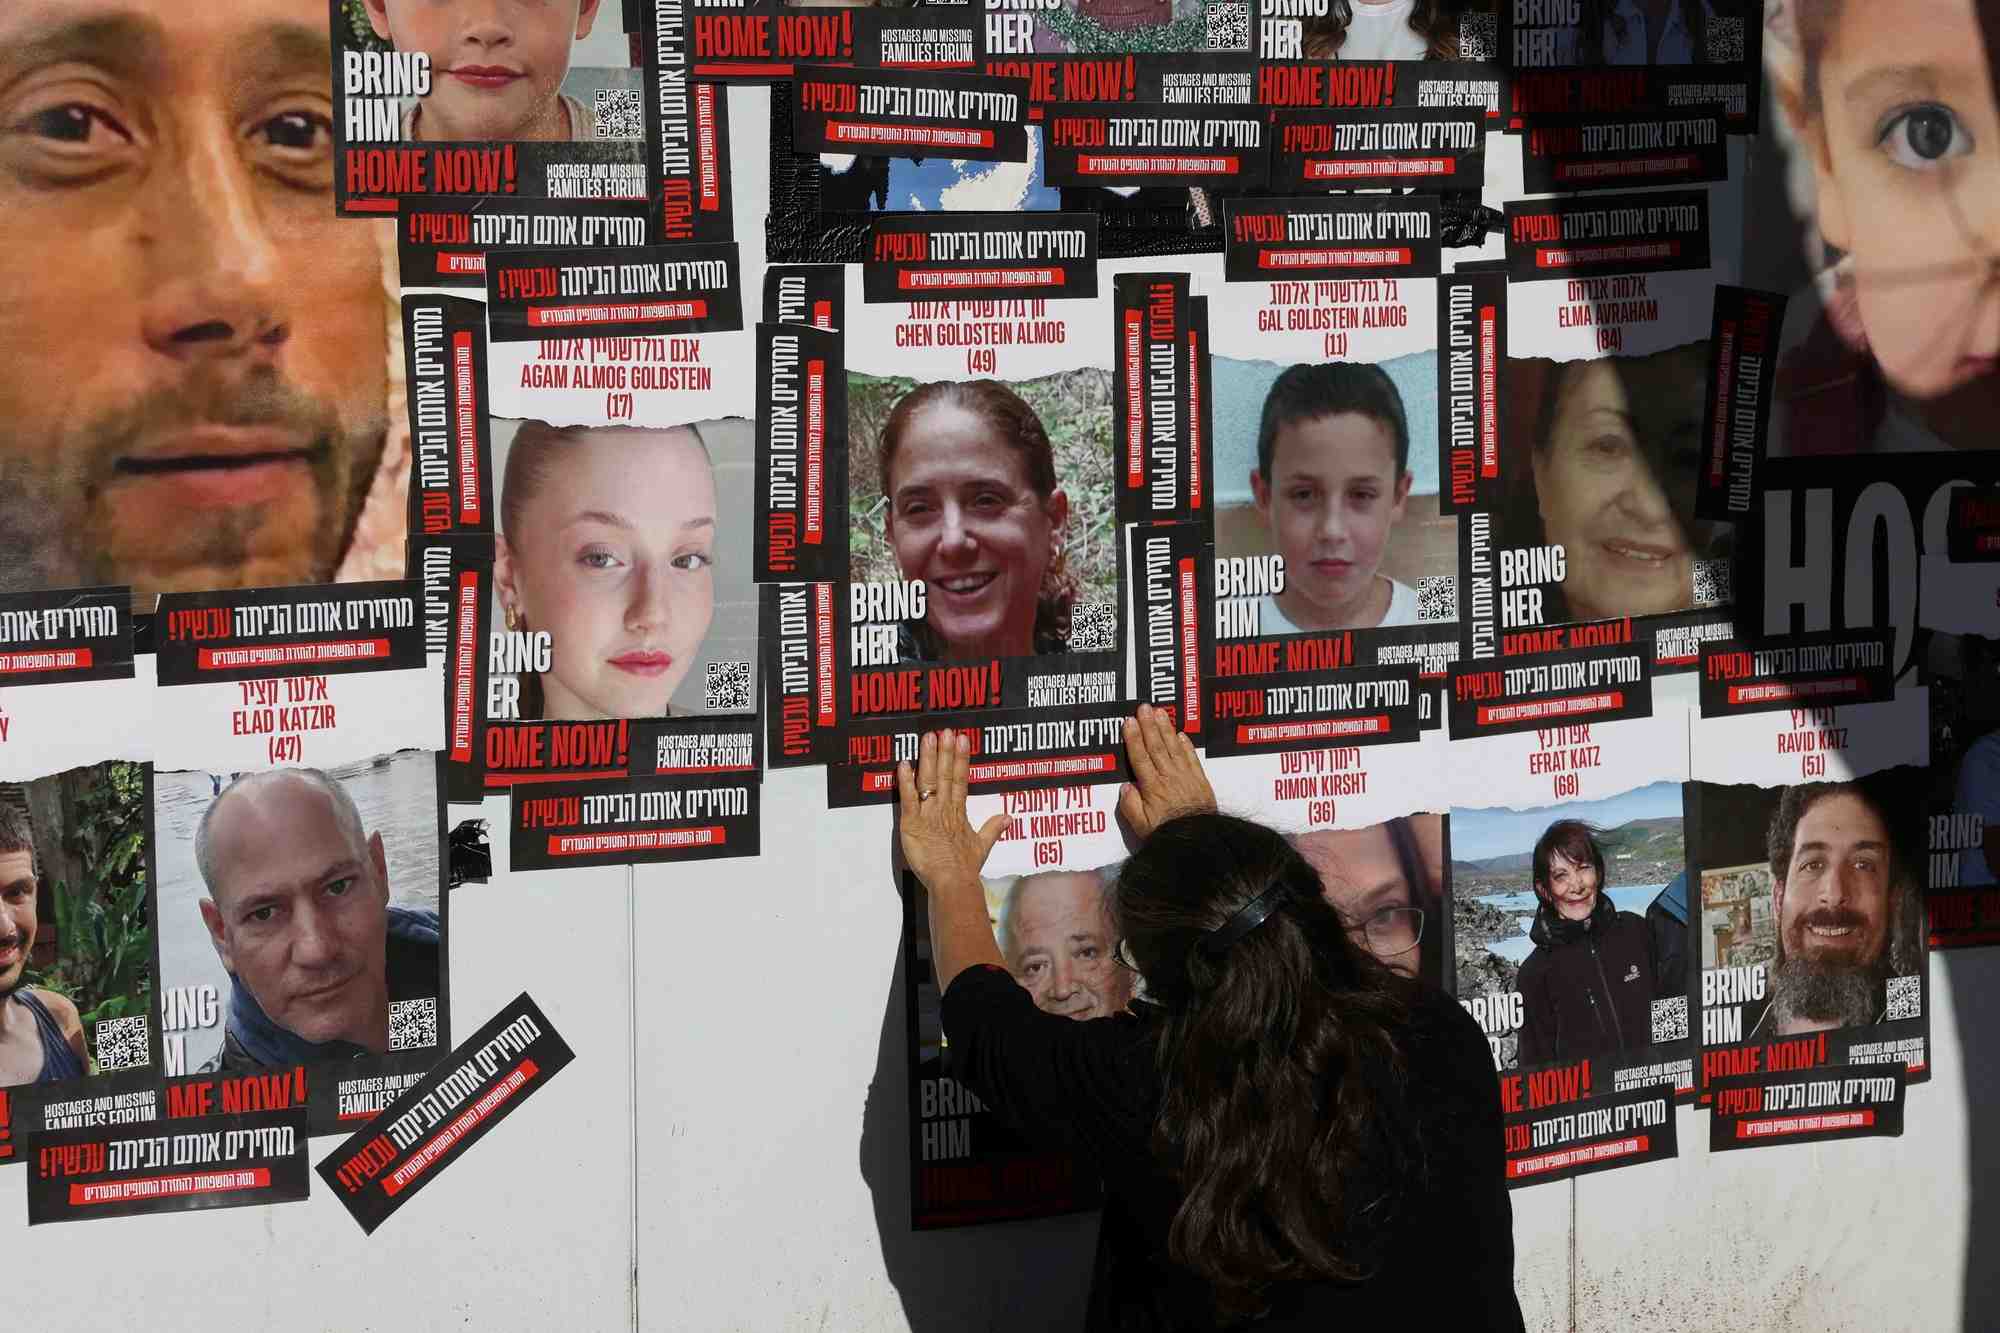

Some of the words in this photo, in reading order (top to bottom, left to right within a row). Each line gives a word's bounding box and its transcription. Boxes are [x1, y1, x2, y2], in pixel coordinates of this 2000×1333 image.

[695, 15, 770, 57] HOME
[777, 10, 854, 57] NOW!
[881, 29, 921, 43] HOSTAGES
[922, 29, 937, 43] AND
[939, 29, 972, 43] MISSING
[986, 14, 1034, 54] HER
[1260, 20, 1303, 59] HER
[881, 43, 931, 63] FAMILIES
[934, 43, 973, 63] FORUM
[343, 51, 431, 97] BRING
[1063, 55, 1136, 101] NOW!
[1259, 66, 1322, 106] HOME
[1329, 63, 1397, 107] NOW!
[803, 82, 856, 112] עכשיו!
[860, 85, 910, 116] הביתה
[914, 88, 954, 120] אותם
[959, 91, 1017, 122] מחזירים
[345, 98, 400, 142] HIM
[346, 149, 427, 194] HOME
[435, 144, 516, 193] NOW!
[547, 164, 588, 179] HOSTAGES
[590, 164, 607, 179] AND
[610, 163, 646, 179] MISSING
[547, 179, 602, 198] FAMILIES
[605, 179, 646, 197] FORUM
[410, 213, 471, 244] עכשיו!
[474, 214, 528, 244] הביתה
[533, 215, 577, 245] אותם
[583, 216, 645, 246] מחזירים
[874, 232, 927, 262] עכשיו!
[930, 231, 980, 261] הביתה
[984, 231, 1023, 260] אותם
[1028, 230, 1086, 259] מחזירים
[499, 267, 557, 300] עכשיו!
[561, 266, 616, 297] הביתה
[620, 264, 661, 294] אותם
[665, 260, 728, 291] מחזירים
[1383, 279, 1398, 301] גל
[1270, 281, 1309, 305] אלמוג
[1314, 280, 1377, 306] גולדשטיין
[1150, 283, 1176, 340] עכשיו!
[1258, 310, 1283, 331] GAL
[1288, 308, 1359, 330] GOLDSTEIN
[1363, 306, 1406, 328] ALMOG
[1559, 305, 1592, 327] ELMA
[1596, 301, 1658, 325] AVRAHAM
[896, 324, 932, 347] CHEN
[937, 322, 1012, 345] GOLDSTEIN
[1017, 321, 1065, 344] ALMOG
[1325, 332, 1347, 357] (11)
[1597, 327, 1622, 351] (84)
[671, 339, 700, 362] אגם
[967, 348, 996, 374] (49)
[521, 365, 567, 388] AGAM
[573, 365, 626, 389] ALMOG
[632, 366, 711, 390] GOLDSTEIN
[771, 336, 798, 401] מחזירים
[1150, 344, 1176, 397] הביתה
[607, 393, 633, 420] (17)
[771, 406, 798, 450] אותם
[1151, 401, 1176, 443] אותם
[770, 454, 797, 508] הביתה
[1151, 446, 1176, 510] מחזירים
[768, 512, 797, 572] עכשיו!
[1216, 555, 1284, 596] BRING
[1501, 545, 1565, 587] BRING
[346, 598, 413, 630] מחזירים
[851, 579, 926, 623] BRING
[1502, 588, 1544, 627] HER
[168, 607, 230, 641] עכשיו!
[235, 604, 292, 636] הביתה
[297, 600, 342, 633] אותם
[1216, 600, 1260, 639] HIM
[489, 631, 551, 673] RING
[852, 624, 899, 667] HER
[239, 680, 278, 706] קציר
[287, 677, 327, 702] אלעד
[851, 670, 922, 714] HOME
[929, 660, 1001, 709] NOW!
[1028, 674, 1066, 689] HOSTAGES
[1067, 673, 1082, 687] AND
[1083, 671, 1116, 686] MISSING
[1356, 680, 1409, 709] מחזירים
[487, 677, 520, 719] ER
[1028, 688, 1076, 708] FAMILIES
[1079, 685, 1116, 704] FORUM
[1215, 690, 1264, 720] עכשיו!
[1267, 687, 1313, 716] הביתה
[1316, 683, 1352, 712] אותם
[233, 709, 273, 736] ELAD
[280, 705, 336, 732] KATZIR
[269, 736, 302, 764] (47)
[485, 727, 544, 768] OME
[552, 720, 629, 767] NOW!
[657, 735, 698, 750] HOSTAGES
[699, 735, 716, 749] AND
[717, 733, 752, 748] MISSING
[1778, 733, 1815, 754] RAVID
[1818, 729, 1848, 751] KATZ
[657, 749, 708, 768] FAMILIES
[711, 747, 752, 767] FORUM
[1281, 751, 1324, 775] קירשט
[1329, 748, 1361, 772] רימון
[1529, 748, 1566, 775] EFRAT
[1571, 746, 1601, 770] KATZ
[1801, 754, 1825, 777] (51)
[1275, 777, 1317, 800] RIMON
[1322, 772, 1367, 797] KIRSHT
[1554, 775, 1580, 799] (68)
[522, 797, 579, 828] עכשיו!
[584, 794, 636, 824] הביתה
[641, 791, 683, 821] אותם
[687, 788, 748, 818] מחזירים
[1309, 800, 1336, 826] (36)
[1031, 811, 1106, 839] KIMENFELD
[1034, 841, 1063, 867] (65)
[1702, 965, 1766, 1006] BRING
[162, 984, 217, 1030] RING
[1703, 1007, 1742, 1046] HIM
[474, 1014, 542, 1077] מחזירים
[435, 1060, 487, 1110] אותם
[1529, 1059, 1592, 1109] NOW!
[1764, 1084, 1805, 1111] הביתה
[1808, 1081, 1841, 1107] אותם
[1844, 1078, 1895, 1104] מחזירים
[45, 1099, 92, 1118] HOSTAGES
[94, 1095, 113, 1112] AND
[115, 1090, 156, 1109] MISSING
[1718, 1087, 1763, 1116] עכשיו!
[387, 1093, 447, 1150] הביתה
[109, 1137, 168, 1171] הביתה
[174, 1132, 222, 1165] אותם
[226, 1127, 295, 1161] מחזירים
[40, 1143, 104, 1178] עכשיו!
[336, 1133, 398, 1192] עכשיו!
